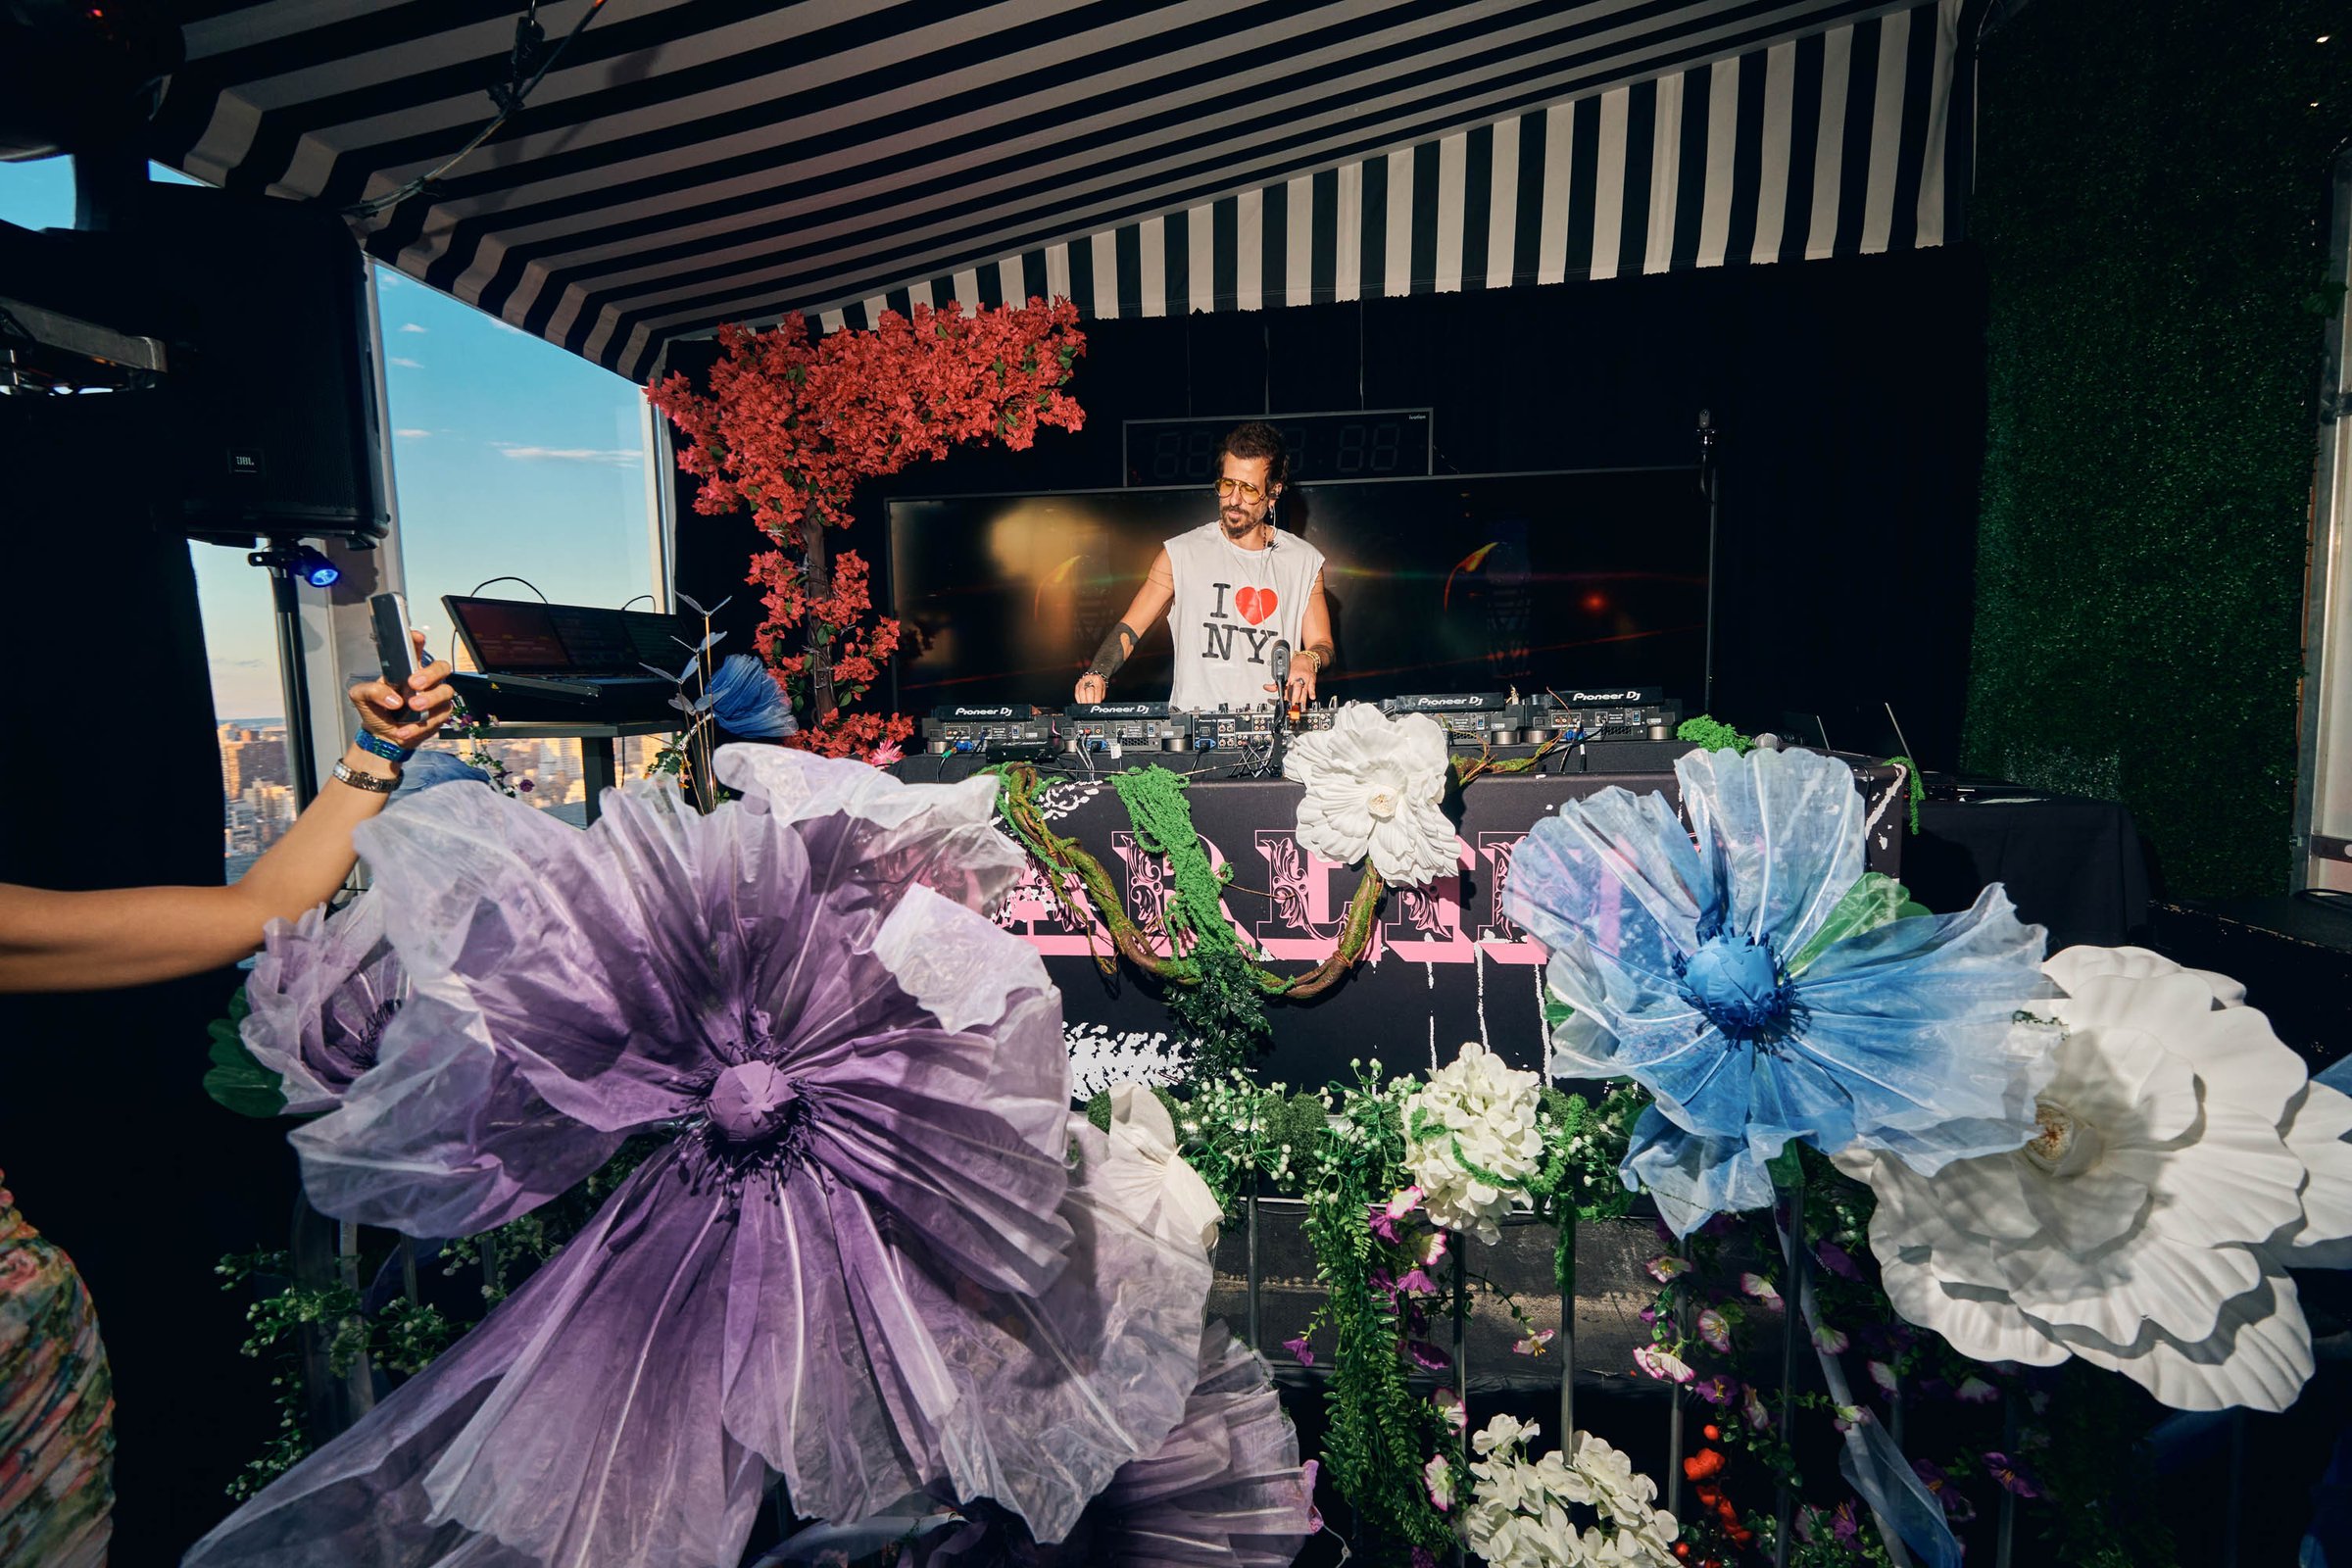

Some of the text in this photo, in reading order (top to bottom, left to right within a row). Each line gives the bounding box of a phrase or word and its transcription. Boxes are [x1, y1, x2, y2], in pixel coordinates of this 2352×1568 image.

[235, 456, 255, 466] JBL
[1209, 582, 1231, 619] I
[1201, 622, 1279, 664] NY
[1417, 697, 1467, 707] Pioneer
[1572, 692, 1625, 702] Pioneer
[955, 707, 999, 716] Pioneer
